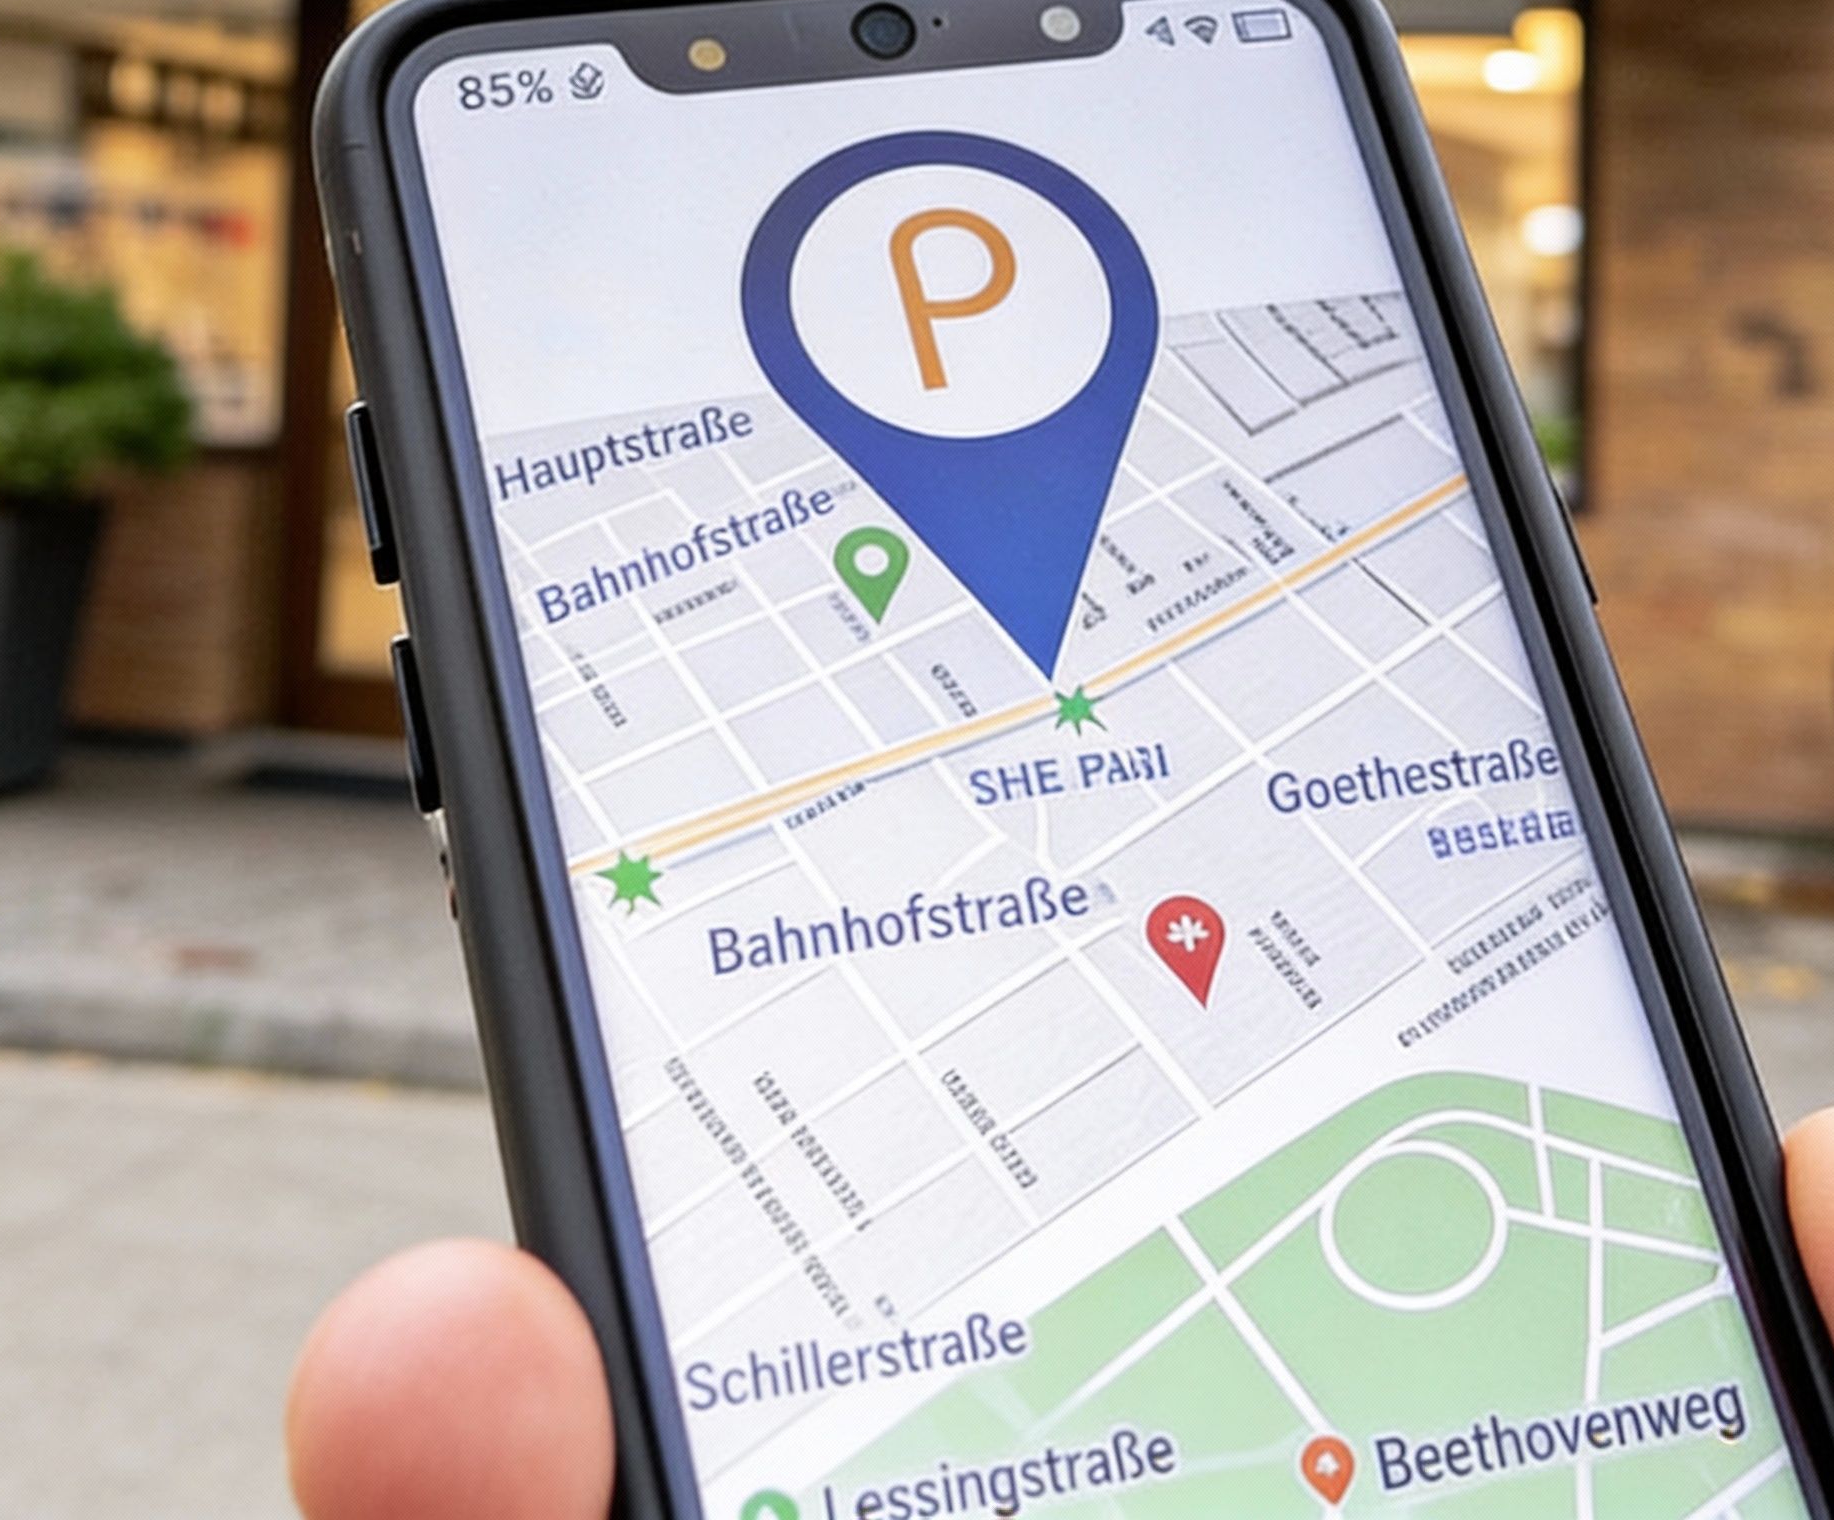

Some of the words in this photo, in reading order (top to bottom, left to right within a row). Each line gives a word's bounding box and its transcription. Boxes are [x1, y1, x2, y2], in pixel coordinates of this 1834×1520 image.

[458, 70, 554, 110] 85%
[889, 208, 1016, 390] P
[495, 407, 753, 500] Hauptstraße
[536, 488, 835, 624] Bahnhofstraße
[970, 759, 1063, 805] SHE
[1267, 739, 1560, 813] Goethestraße
[708, 877, 1089, 975] Bahnhofstraße
[685, 1313, 1028, 1411] Schillerstraße
[1376, 1384, 1745, 1491] Beethovenweg
